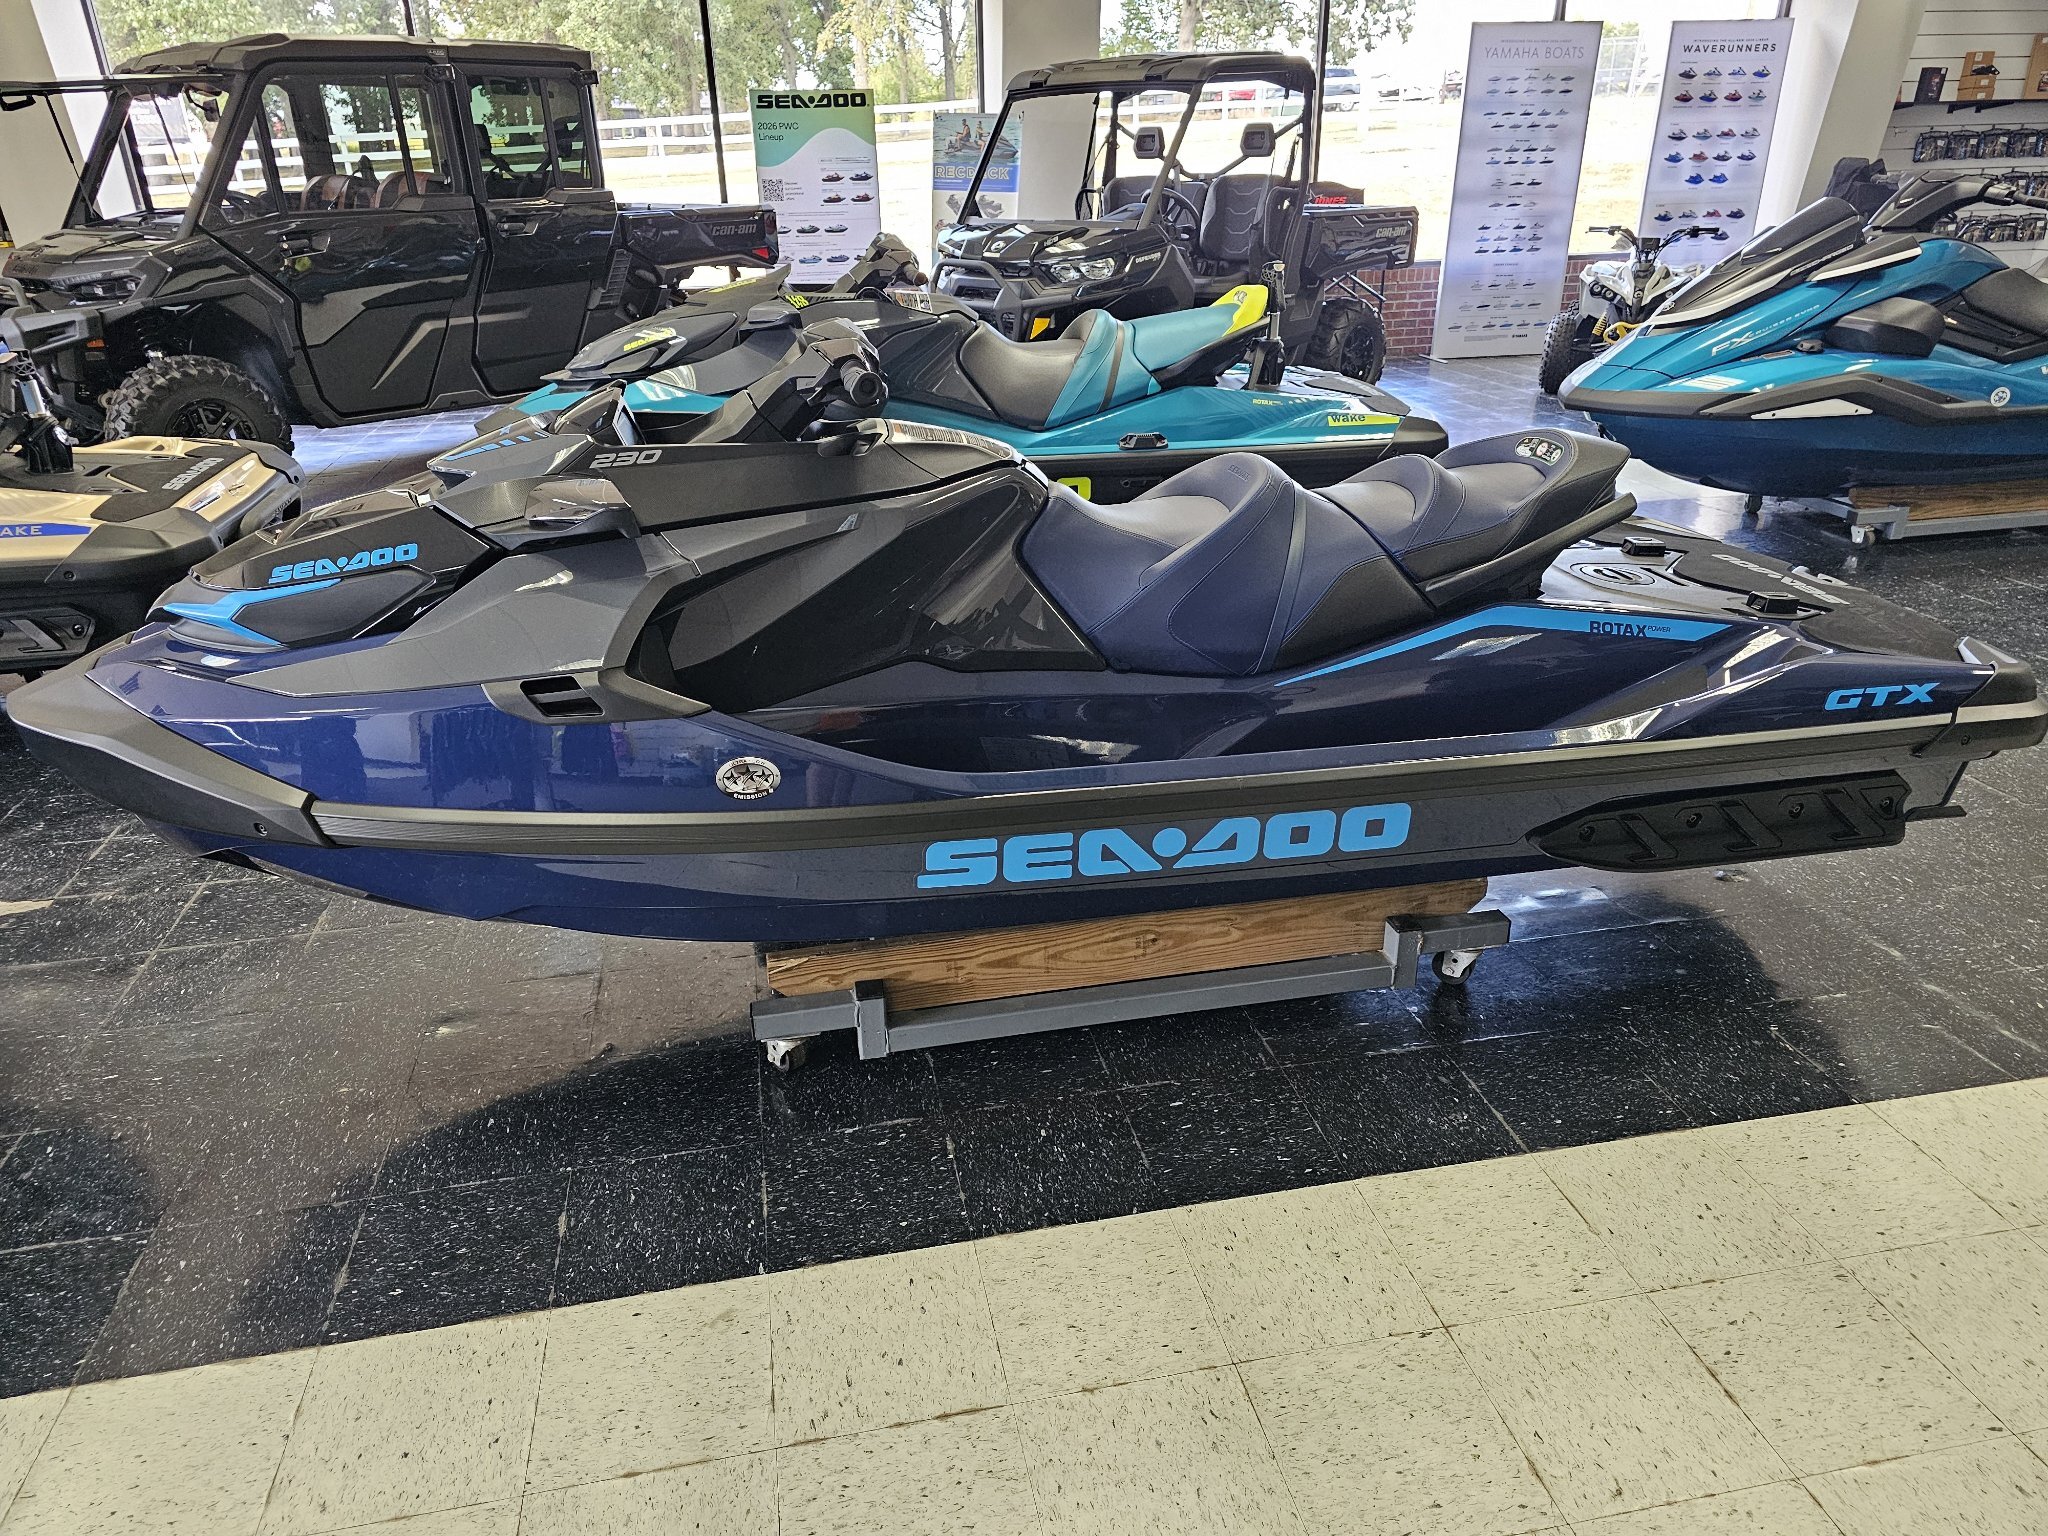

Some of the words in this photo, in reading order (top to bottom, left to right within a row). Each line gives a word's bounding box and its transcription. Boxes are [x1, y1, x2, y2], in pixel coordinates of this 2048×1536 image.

[1484, 46, 1539, 59] YAMAHA
[1544, 46, 1585, 59] BOATS
[1683, 43, 1777, 53] WAVERUNNERS
[757, 122, 778, 130] 2026
[779, 122, 799, 130] PWC
[758, 133, 784, 142] Lineup
[934, 165, 1010, 180] RECDCK
[1711, 331, 1753, 356] FX
[1331, 413, 1367, 423] wake
[589, 449, 662, 469] 230
[0, 525, 42, 536] AKE
[1589, 620, 1648, 637] ROTAX
[1647, 625, 1671, 633] POWER
[1824, 682, 1941, 711] GTX
